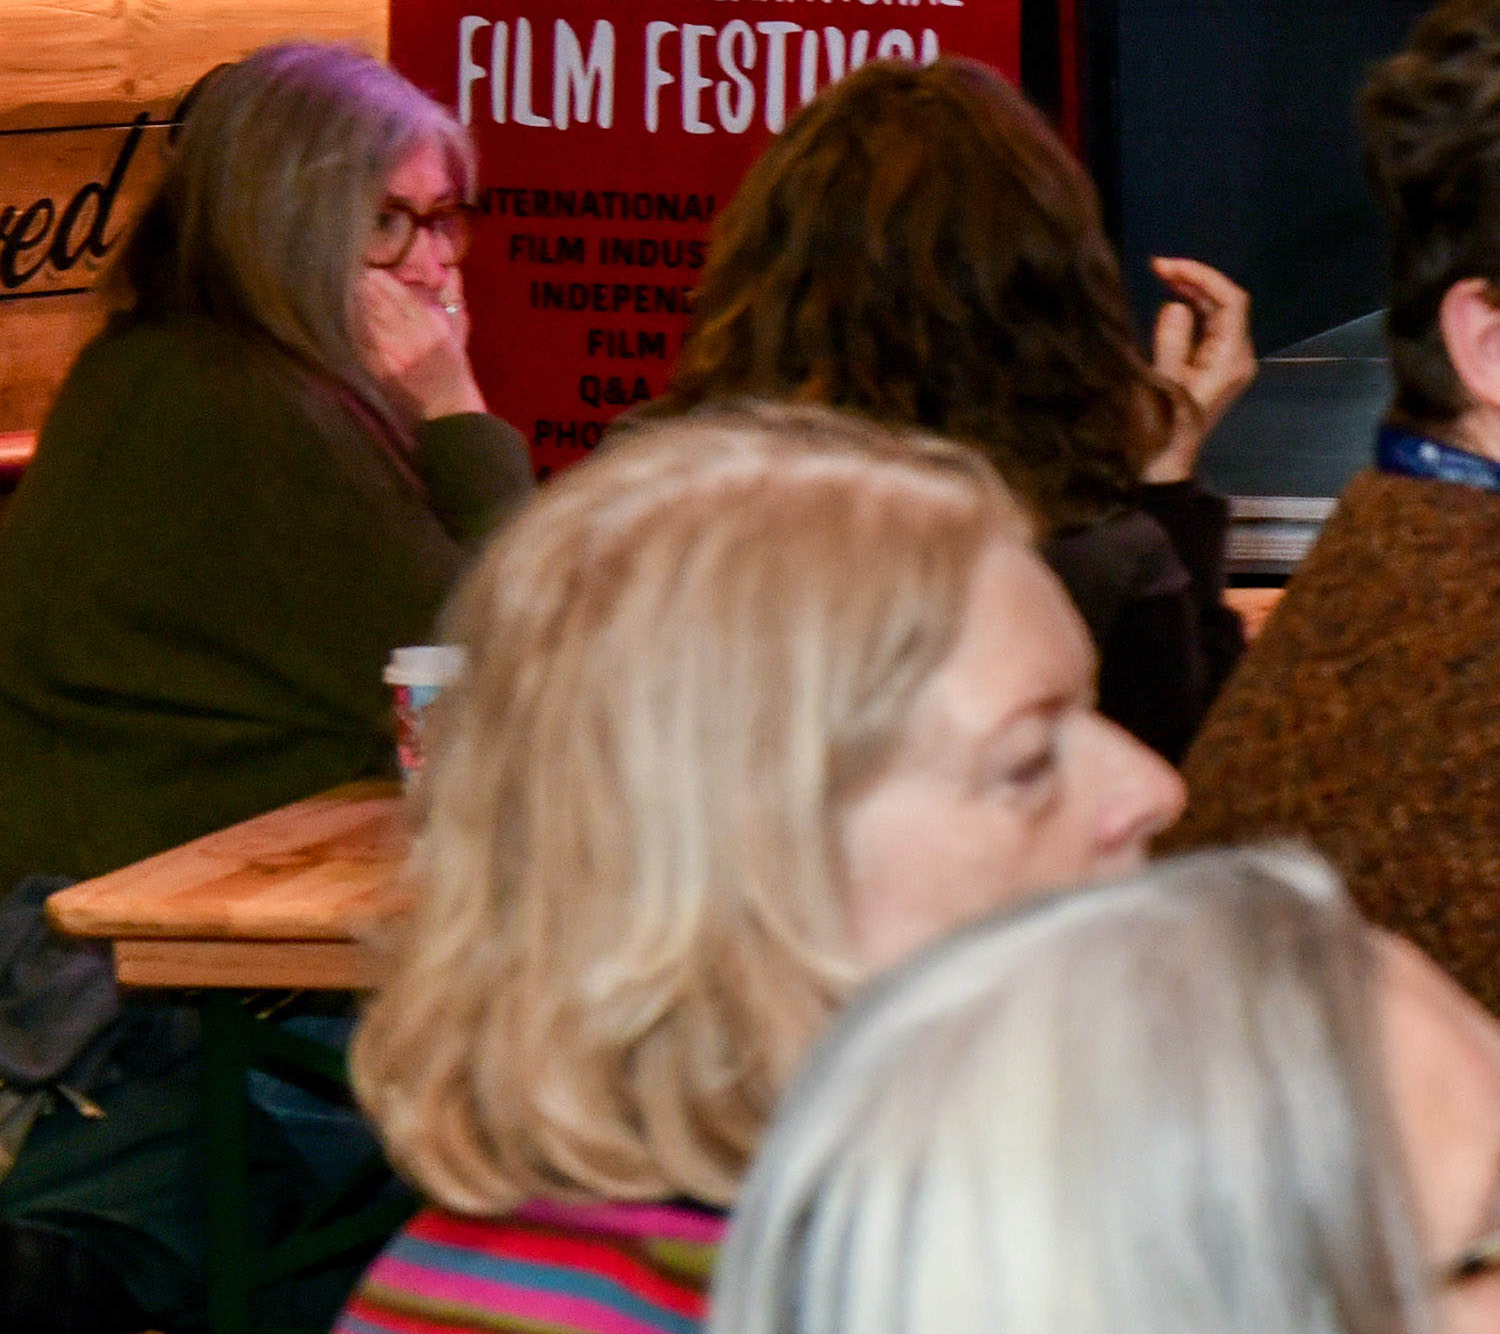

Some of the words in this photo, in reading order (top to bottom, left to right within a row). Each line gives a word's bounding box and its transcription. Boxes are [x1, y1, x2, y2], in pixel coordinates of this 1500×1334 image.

[459, 15, 616, 130] FILM
[481, 187, 714, 221] NTERNATIONA
[508, 234, 585, 264] FILM
[599, 238, 706, 269] INDUS
[530, 280, 693, 314] INDEPEN
[587, 329, 666, 359] FILM
[579, 375, 652, 408] Q&A
